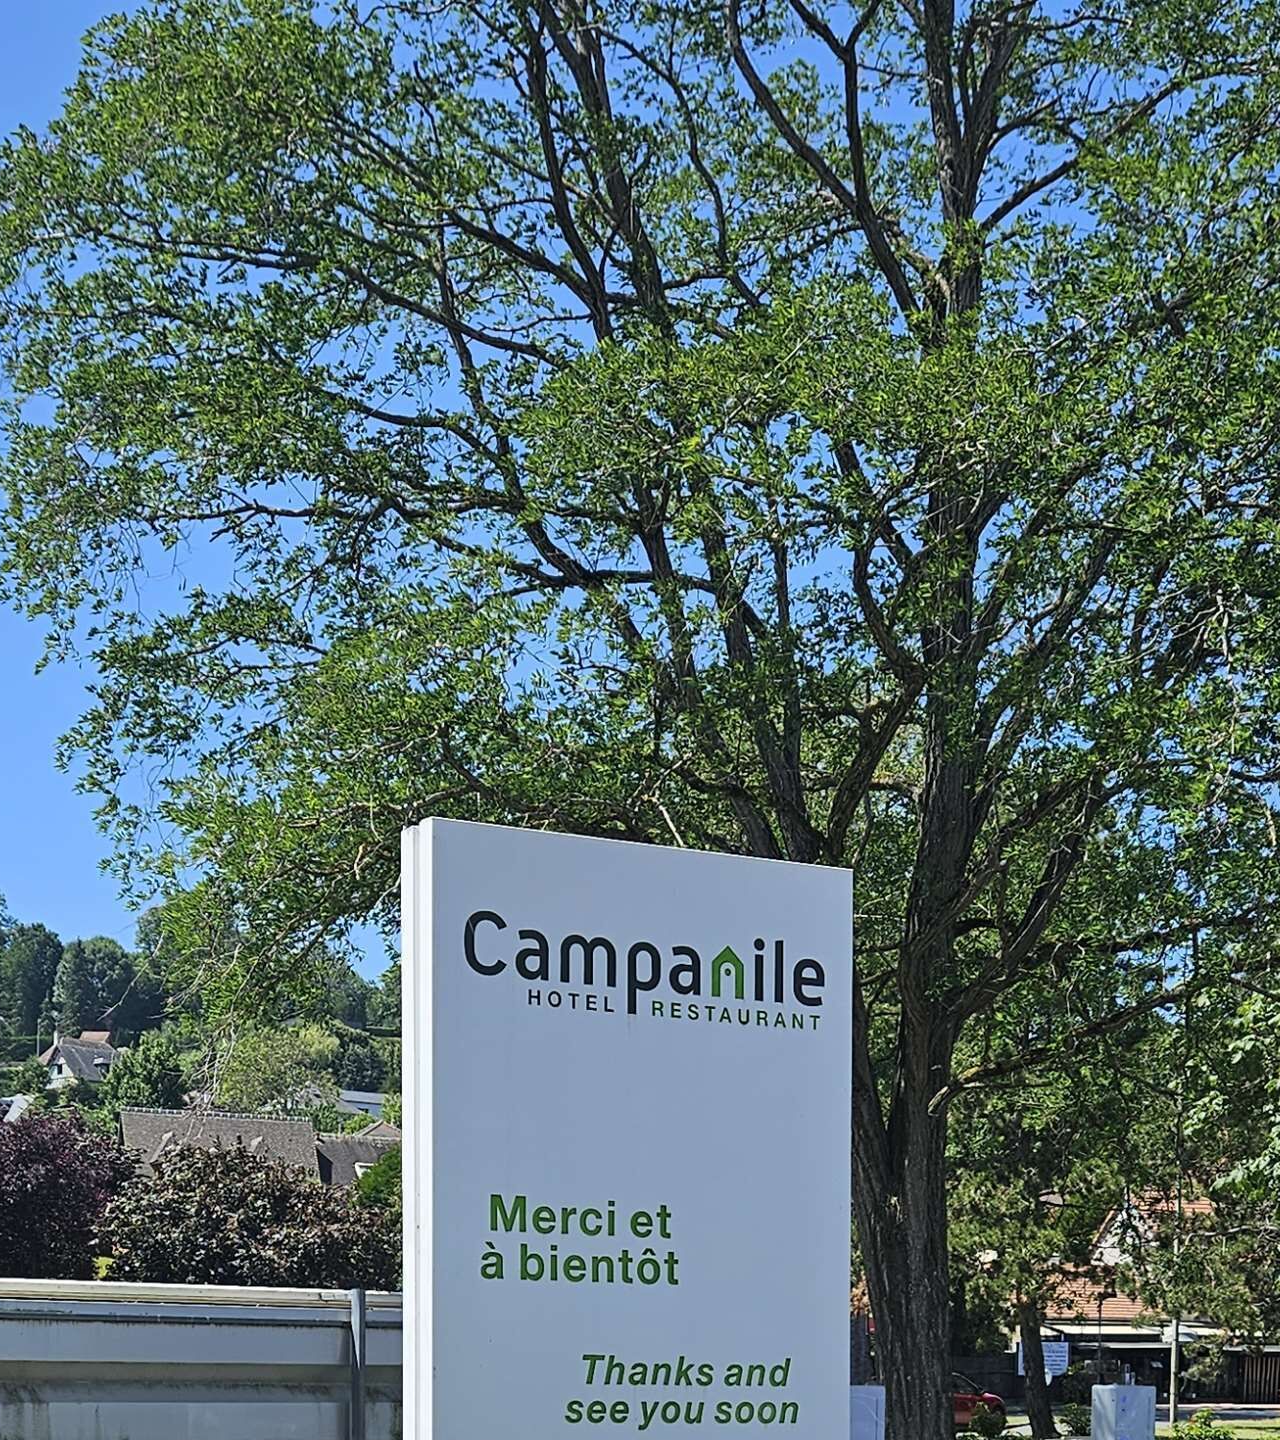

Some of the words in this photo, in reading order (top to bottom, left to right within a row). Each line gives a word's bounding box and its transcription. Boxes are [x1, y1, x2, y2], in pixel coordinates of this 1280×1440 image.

[463, 909, 826, 1015] Campanile
[527, 988, 615, 1013] HOTEL
[651, 1002, 821, 1031] RESTAURANT
[489, 1194, 616, 1237] Merci
[630, 1204, 672, 1239] et
[480, 1241, 505, 1280] à
[520, 1244, 680, 1286] bientôt
[582, 1354, 713, 1387] Thanks
[723, 1357, 791, 1388] and
[564, 1399, 629, 1426] see
[638, 1399, 704, 1431] you
[713, 1399, 800, 1425] soon
